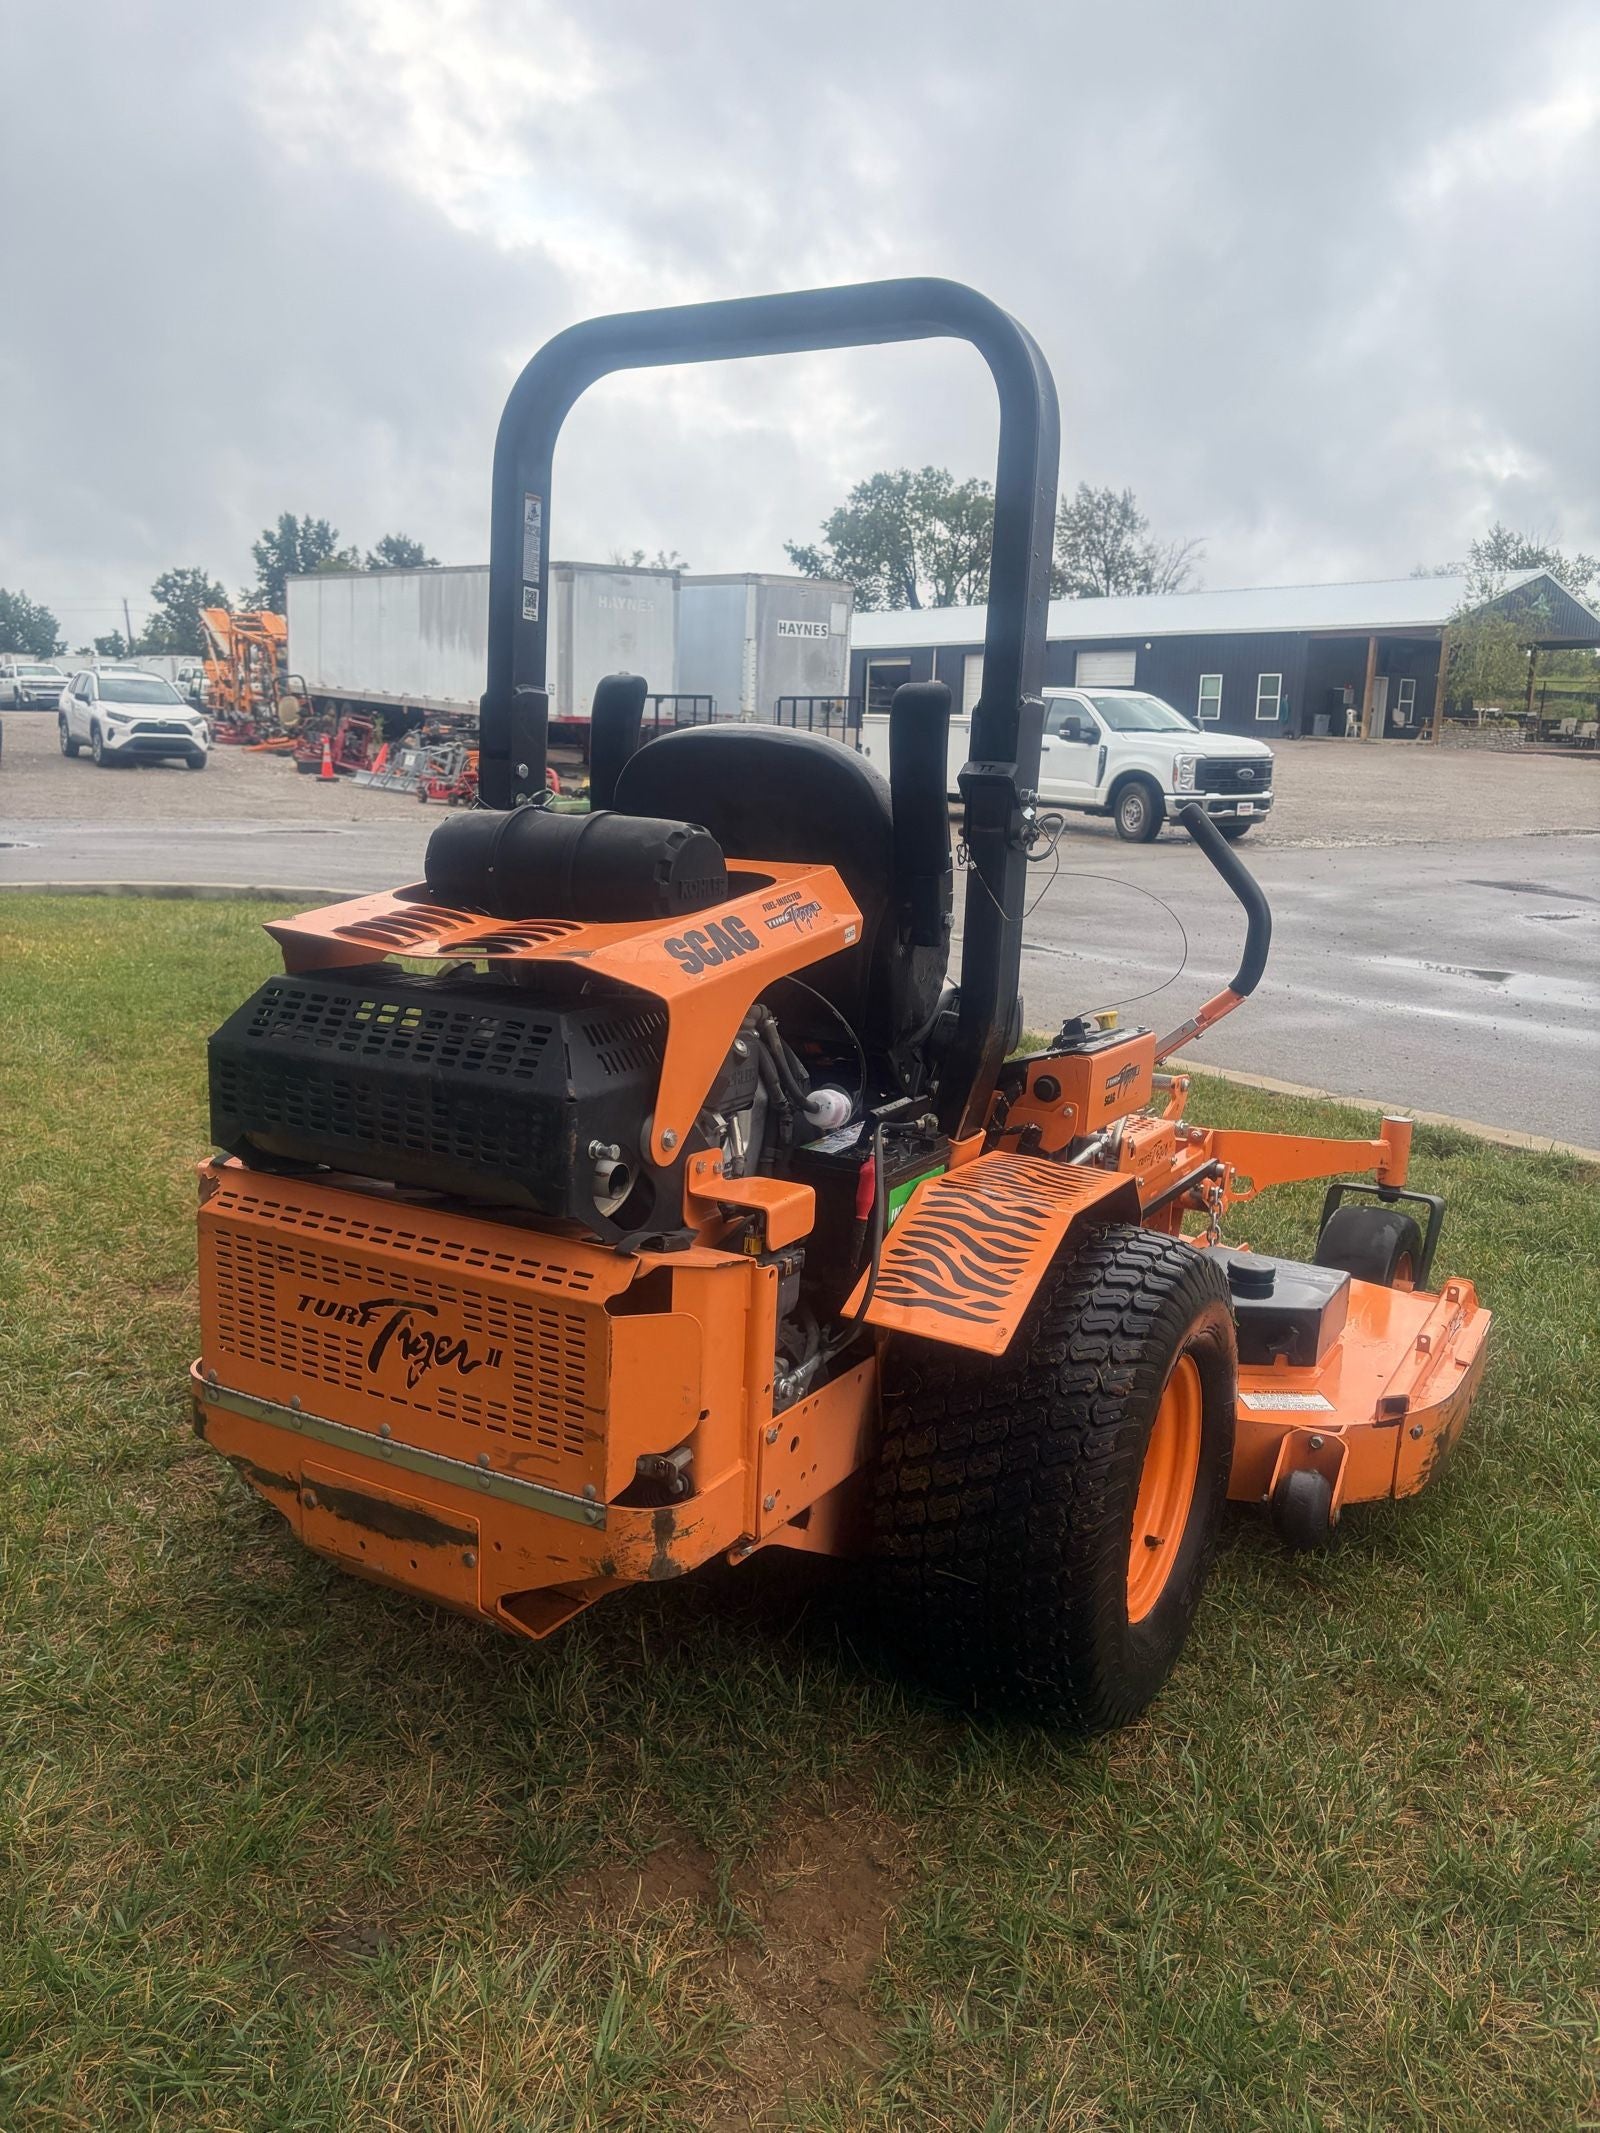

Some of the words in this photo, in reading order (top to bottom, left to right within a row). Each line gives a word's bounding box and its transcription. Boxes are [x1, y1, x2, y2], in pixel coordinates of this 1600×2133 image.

[598, 595, 655, 612] HAYNES
[779, 622, 827, 637] HAYNES
[680, 877, 726, 899] KOHLER
[762, 891, 802, 912] FUEL-INJECTED
[765, 908, 793, 930] TURF
[664, 916, 760, 975] SCAG
[297, 1294, 381, 1328] TURF
[358, 1298, 482, 1389] Tiger
[485, 1347, 503, 1368] II
